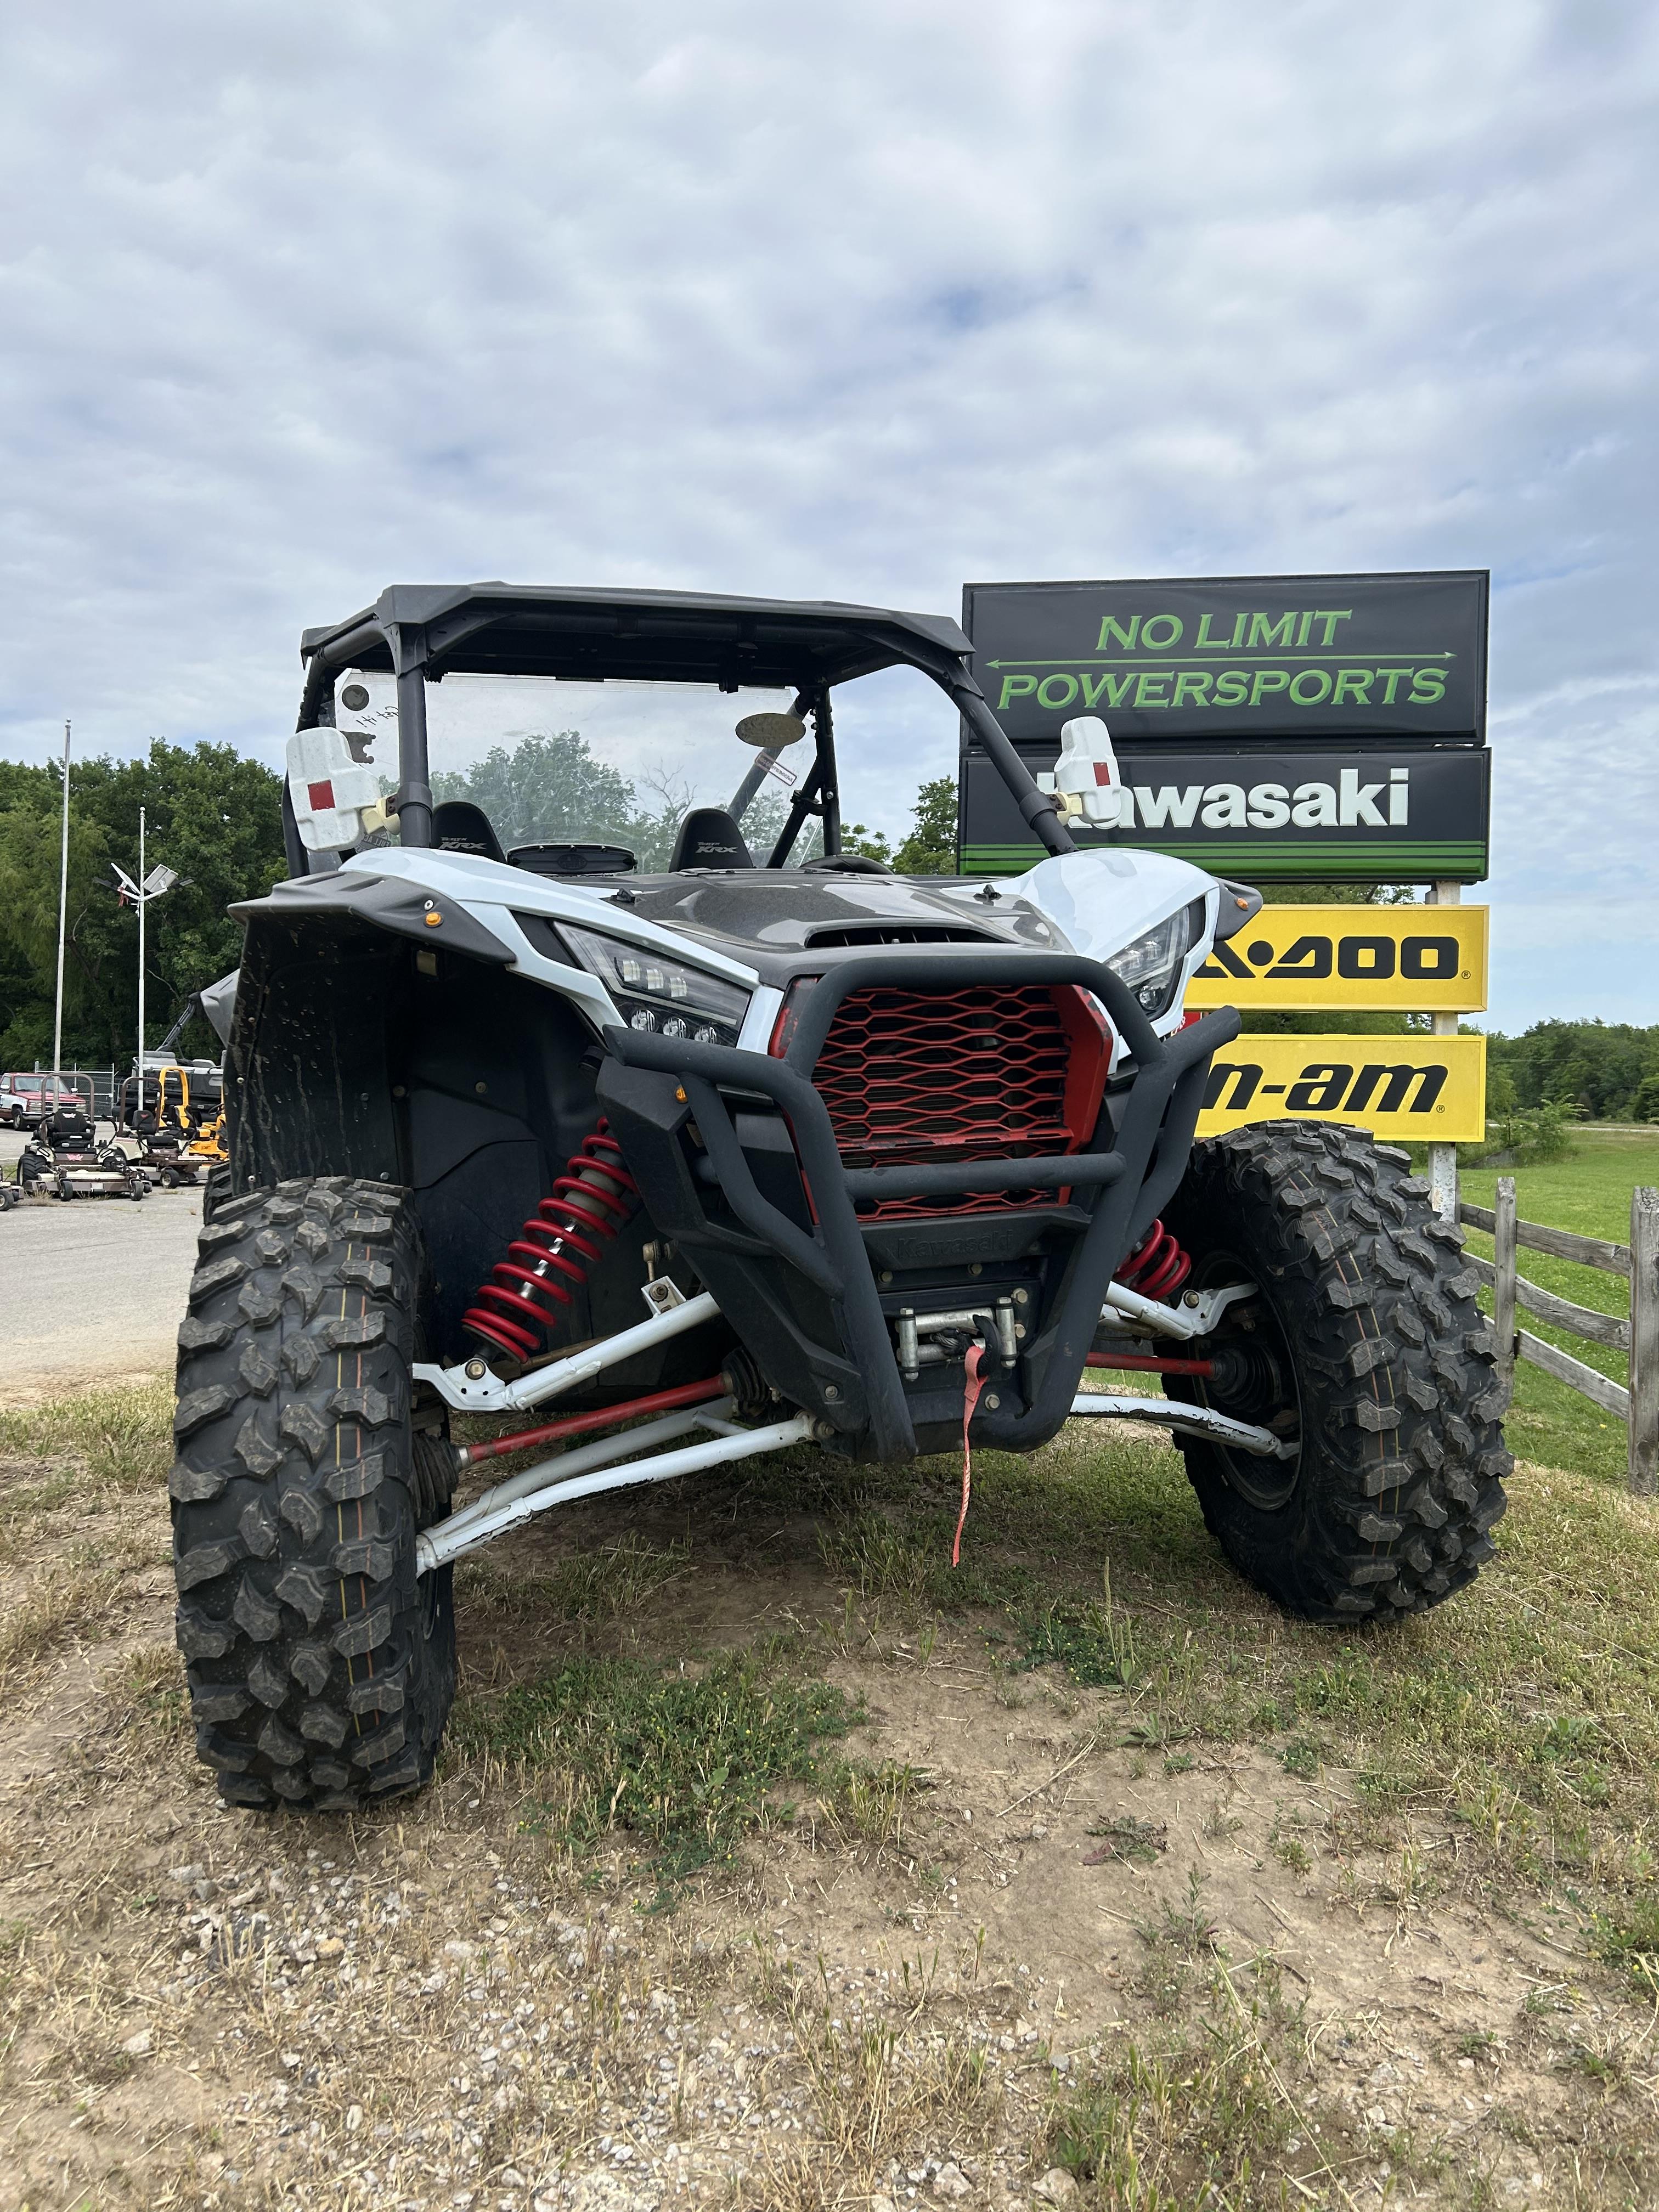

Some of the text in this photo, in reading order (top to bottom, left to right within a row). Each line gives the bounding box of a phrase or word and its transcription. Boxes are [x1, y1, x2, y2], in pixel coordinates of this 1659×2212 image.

[1096, 609, 1352, 651] NO LIMIT
[996, 668, 1449, 710] POWERSPORTS
[438, 842, 487, 850] KRX
[1199, 1063, 1449, 1113] n-am
[898, 1229, 1014, 1259] Kawasaki
